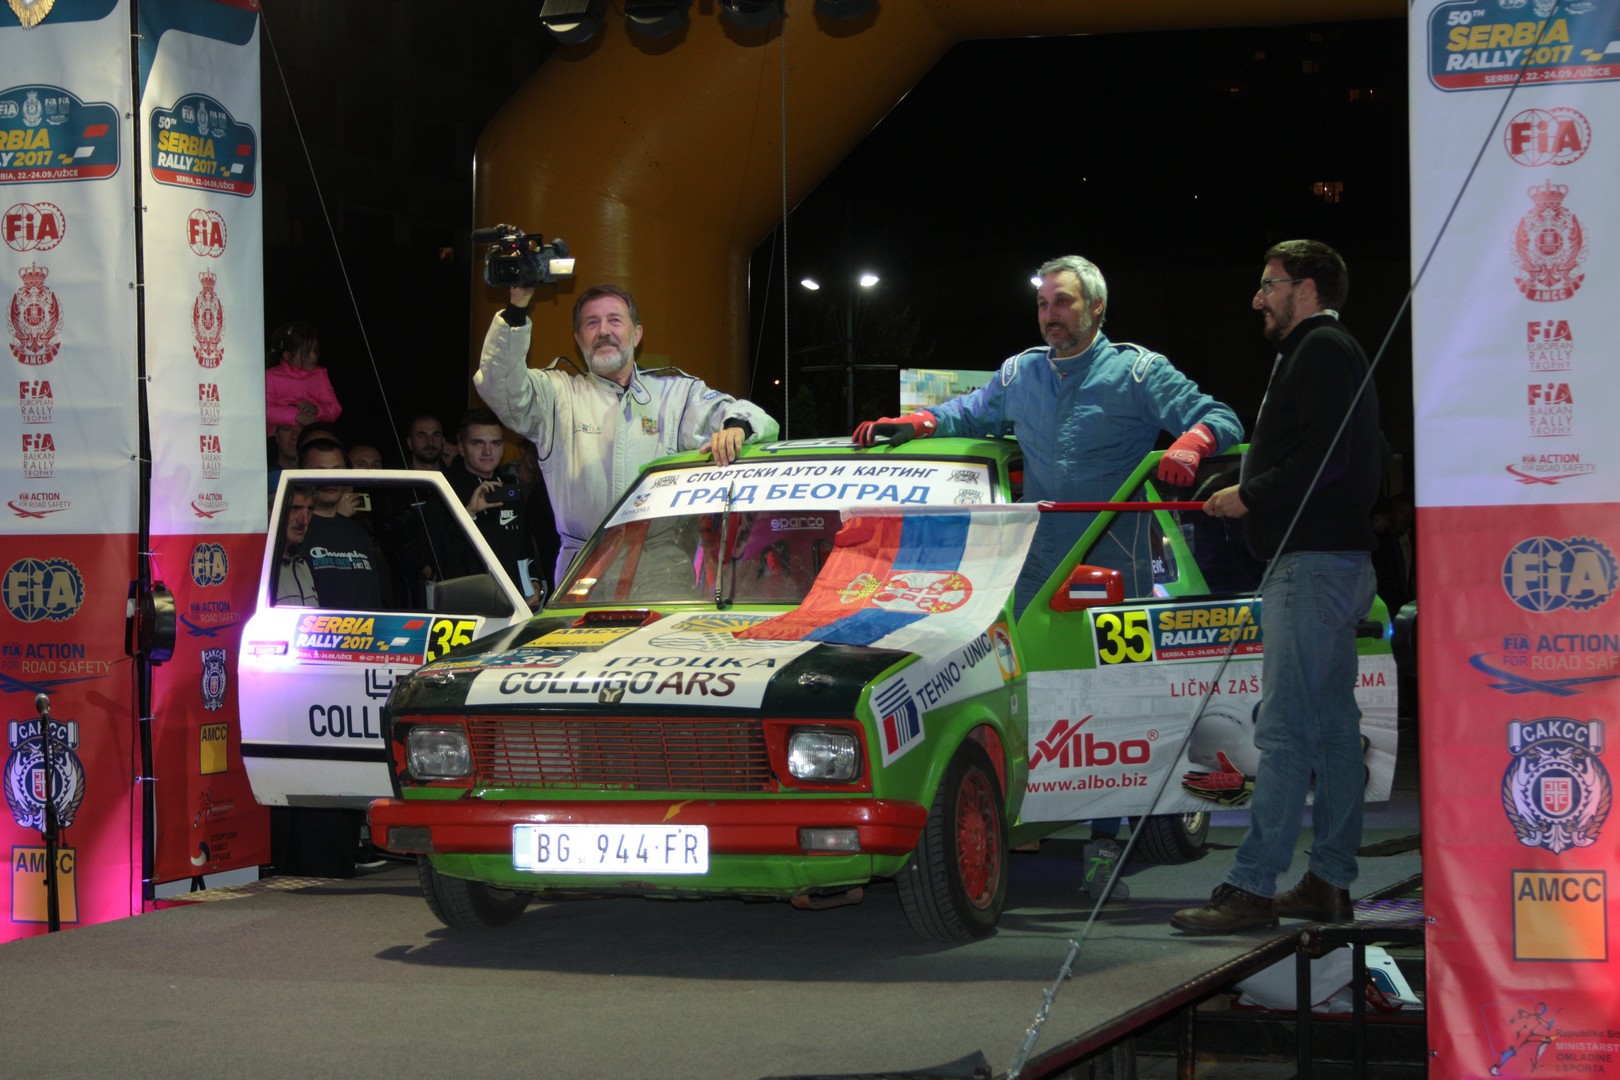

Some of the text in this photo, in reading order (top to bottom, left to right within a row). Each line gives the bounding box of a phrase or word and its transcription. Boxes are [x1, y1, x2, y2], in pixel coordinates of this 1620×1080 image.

[1446, 19, 1569, 51] SERBIA
[1446, 45, 1574, 71] RALLY 2017
[157, 130, 215, 159] SERBIA
[13, 150, 53, 166] 2017
[157, 152, 218, 175] RALLY 2017
[1527, 342, 1573, 350] EUROPEAN
[1529, 350, 1572, 361] RALLY
[1530, 361, 1570, 369] TROPHY
[21, 407, 52, 415] RALLY
[200, 408, 220, 417] RALLY
[1529, 406, 1572, 415] BALKAN
[1529, 416, 1572, 426] RALLY
[23, 461, 54, 469] RALLY
[202, 461, 221, 470] RALLY
[1539, 454, 1580, 463] ACTION
[687, 467, 777, 484] СПОРТСКИ
[780, 466, 827, 477] АУТО
[830, 466, 846, 476] И
[852, 466, 938, 478] КАРТИНГ
[1536, 464, 1560, 472] ROAD
[31, 492, 60, 500] ACTION
[205, 493, 222, 501] ACTION
[669, 483, 931, 508] ГРАД БЕОГРАД
[770, 516, 825, 530] sparco
[202, 601, 230, 612] ACTION
[201, 614, 218, 622] ROAD
[299, 615, 375, 635] SERBIA
[1158, 606, 1255, 631] SERBIA
[296, 634, 375, 650] RALLY 2017
[427, 620, 476, 662] 35
[1095, 611, 1152, 664] 35
[1160, 625, 1259, 646] RALLY 2017
[1536, 633, 1619, 652] ACTION
[26, 643, 85, 658] ACTION
[22, 661, 56, 673] ROAD
[59, 660, 111, 673] SAFETY
[604, 656, 777, 668] ГРОЦКА
[1504, 655, 1528, 666] FOR
[1531, 655, 1580, 670] ROAD
[1170, 675, 1264, 697] LIČNA ZAŠ
[1026, 773, 1148, 793] www.albo.biz
[537, 833, 570, 863] BG
[597, 834, 648, 863] 944
[1556, 1053, 1613, 1063] OMLADINE
[1562, 1064, 1605, 1073] SPORTA
